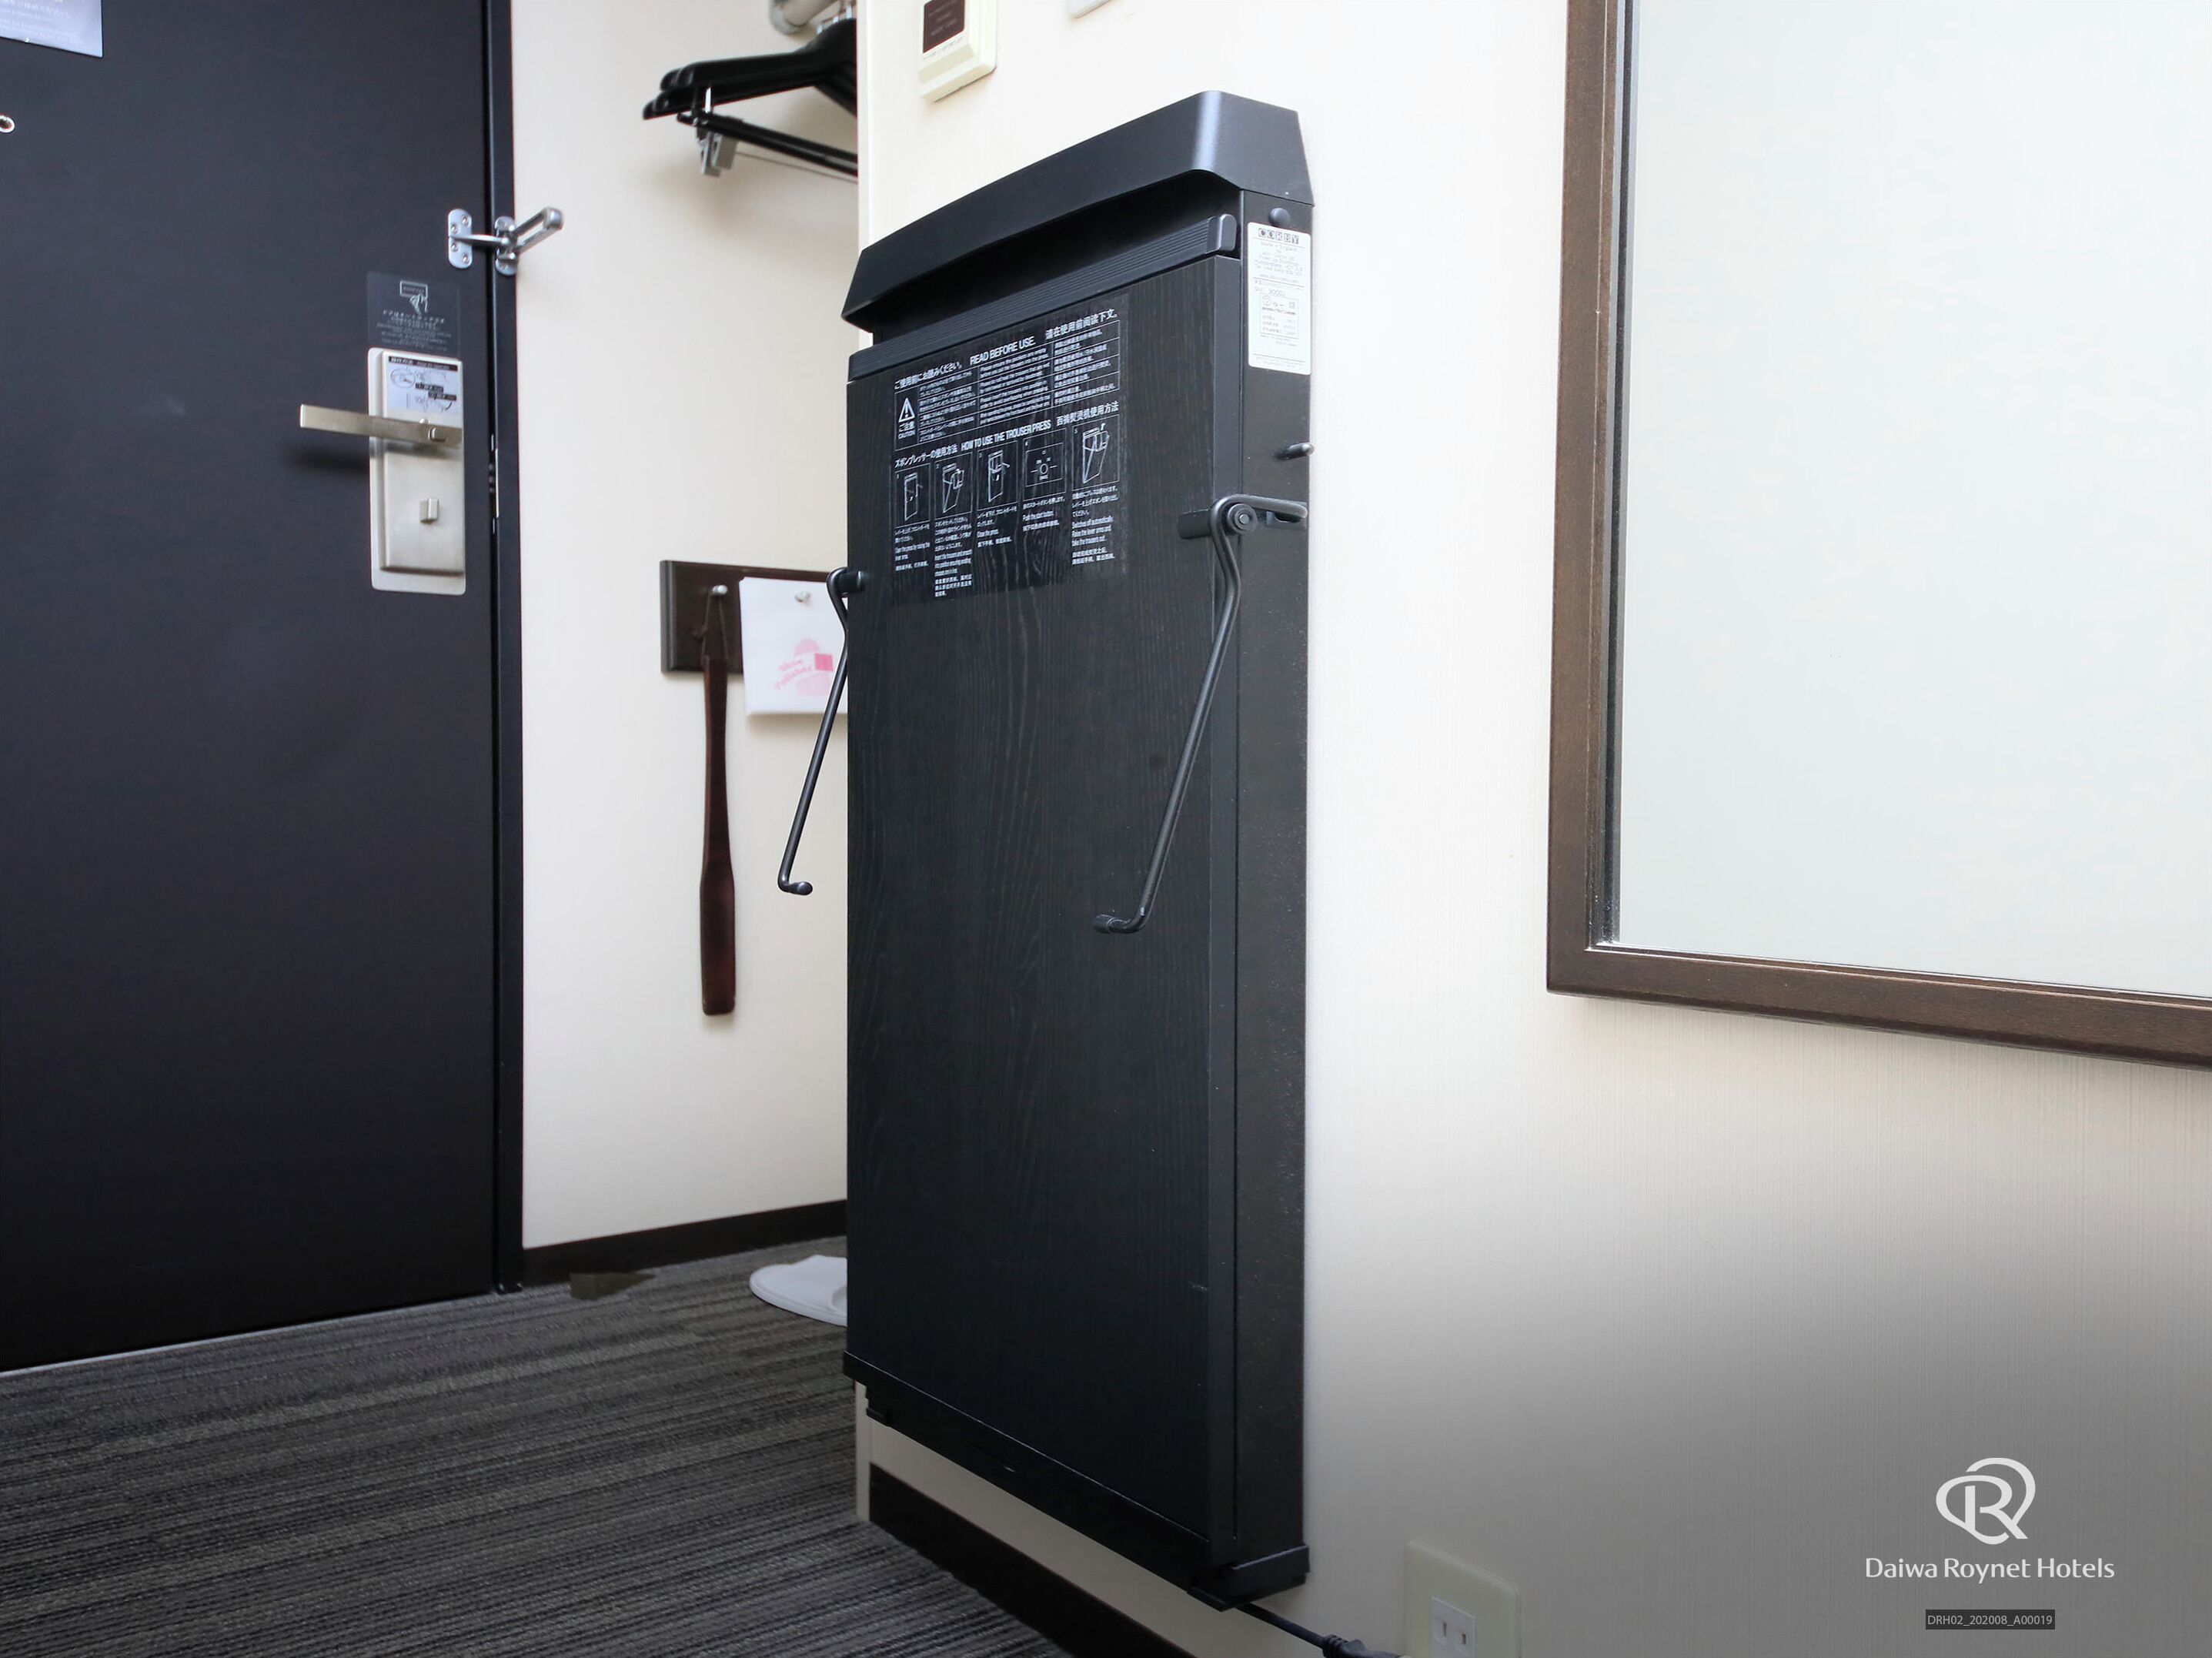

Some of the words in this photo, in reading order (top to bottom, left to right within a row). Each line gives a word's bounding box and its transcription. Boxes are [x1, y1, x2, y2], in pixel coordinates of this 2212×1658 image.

[970, 351, 989, 366] READ
[989, 341, 1018, 359] BEFORE
[961, 440, 974, 451] HOW
[974, 437, 982, 448] TO
[982, 434, 994, 446] USE
[994, 431, 1005, 443] THE
[1006, 424, 1031, 440] TROUSER
[1032, 419, 1051, 433] PRESS
